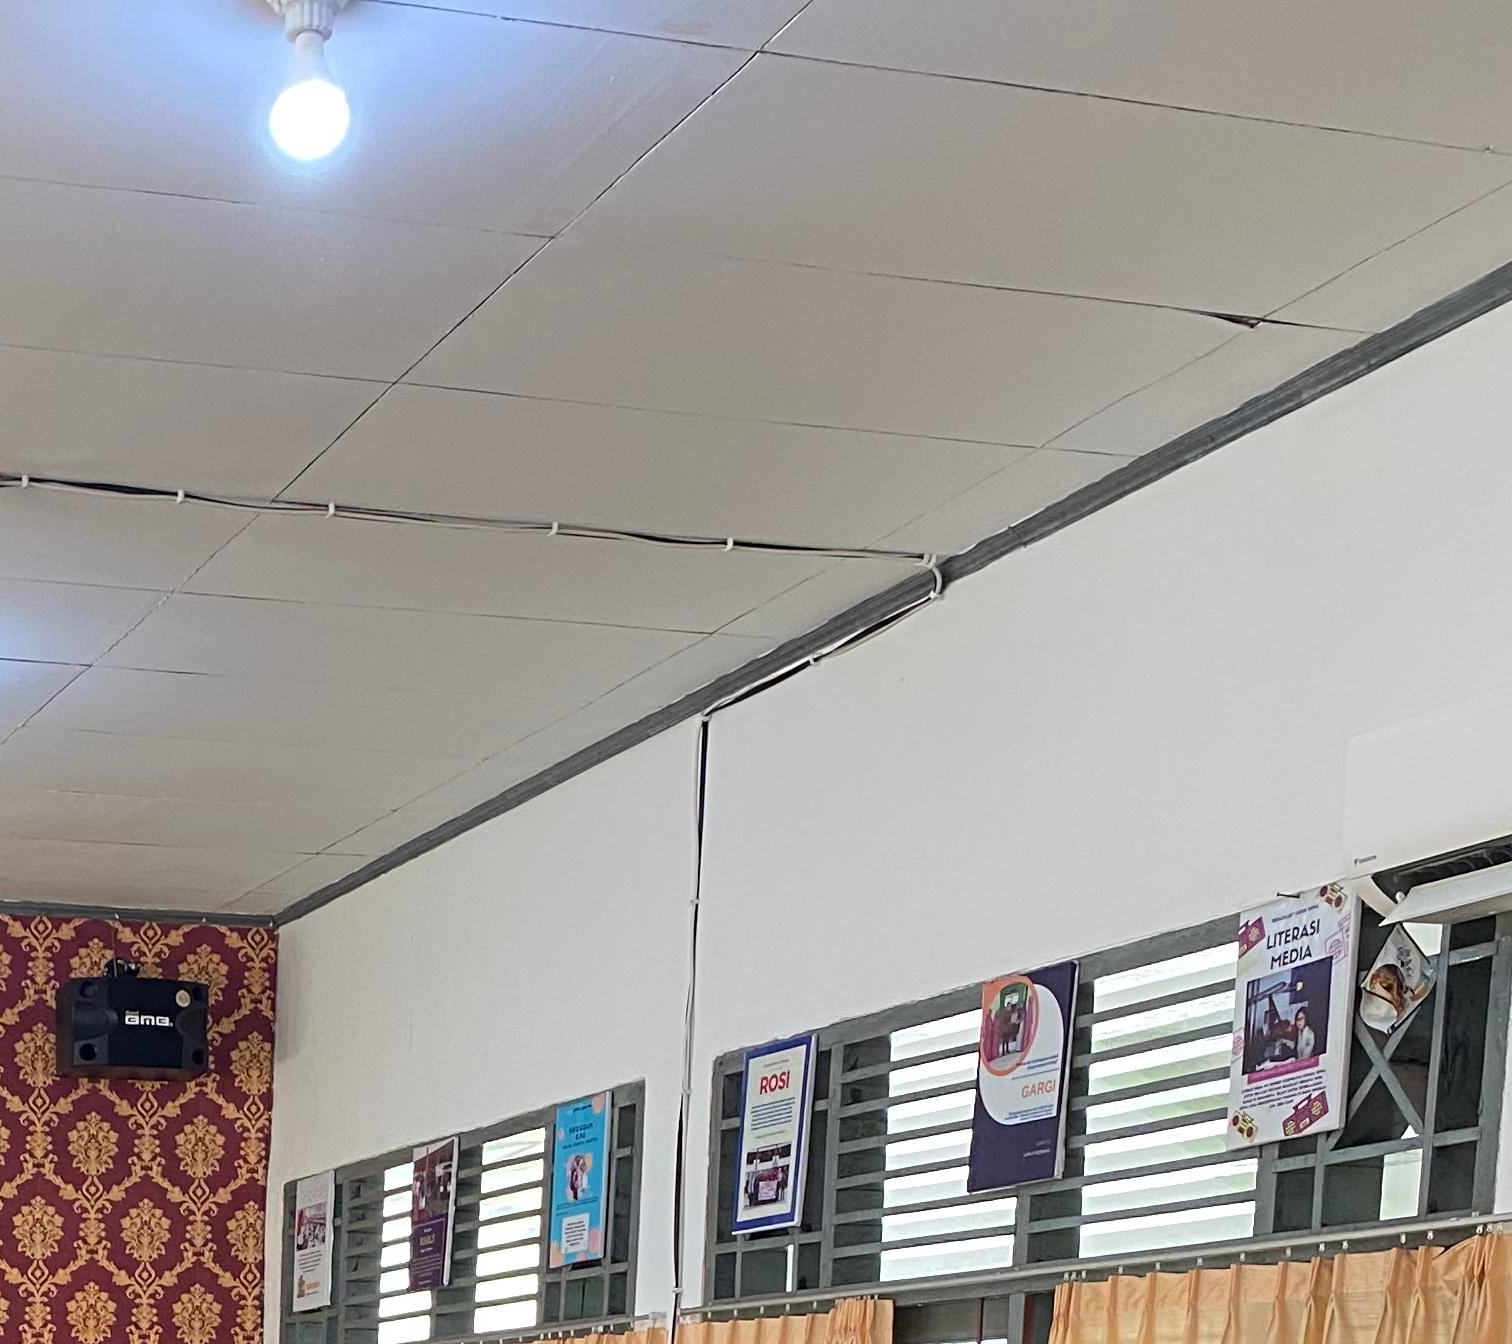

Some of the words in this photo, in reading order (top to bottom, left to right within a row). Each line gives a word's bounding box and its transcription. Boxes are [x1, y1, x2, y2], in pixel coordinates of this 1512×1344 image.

[1266, 918, 1320, 950] LITERASI
[1270, 945, 1313, 970] MEDIA
[759, 1070, 791, 1096] ROSI
[1021, 1079, 1057, 1098] GARGI
